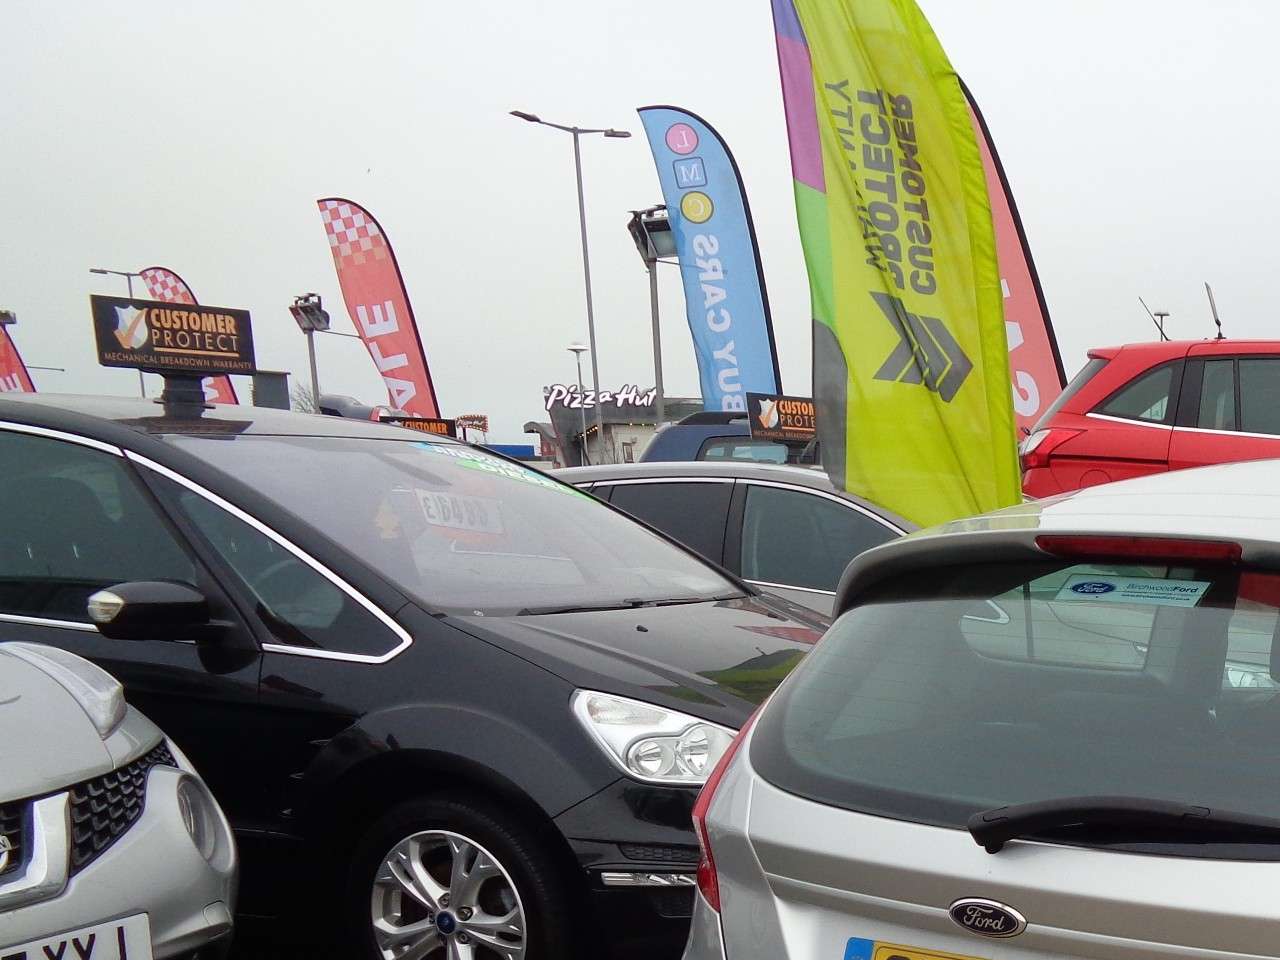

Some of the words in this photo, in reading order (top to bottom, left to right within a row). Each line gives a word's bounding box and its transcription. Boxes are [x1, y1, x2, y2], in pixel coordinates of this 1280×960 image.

[151, 307, 237, 335] CUSTOMER
[151, 328, 240, 352] PROTECT
[104, 353, 158, 364] MECHANICAL
[160, 356, 210, 367] BREAKDOWN
[213, 360, 252, 370] WARRANTY
[546, 383, 613, 409] Pizza
[615, 383, 657, 408] Hut
[963, 906, 1006, 930] Ford
